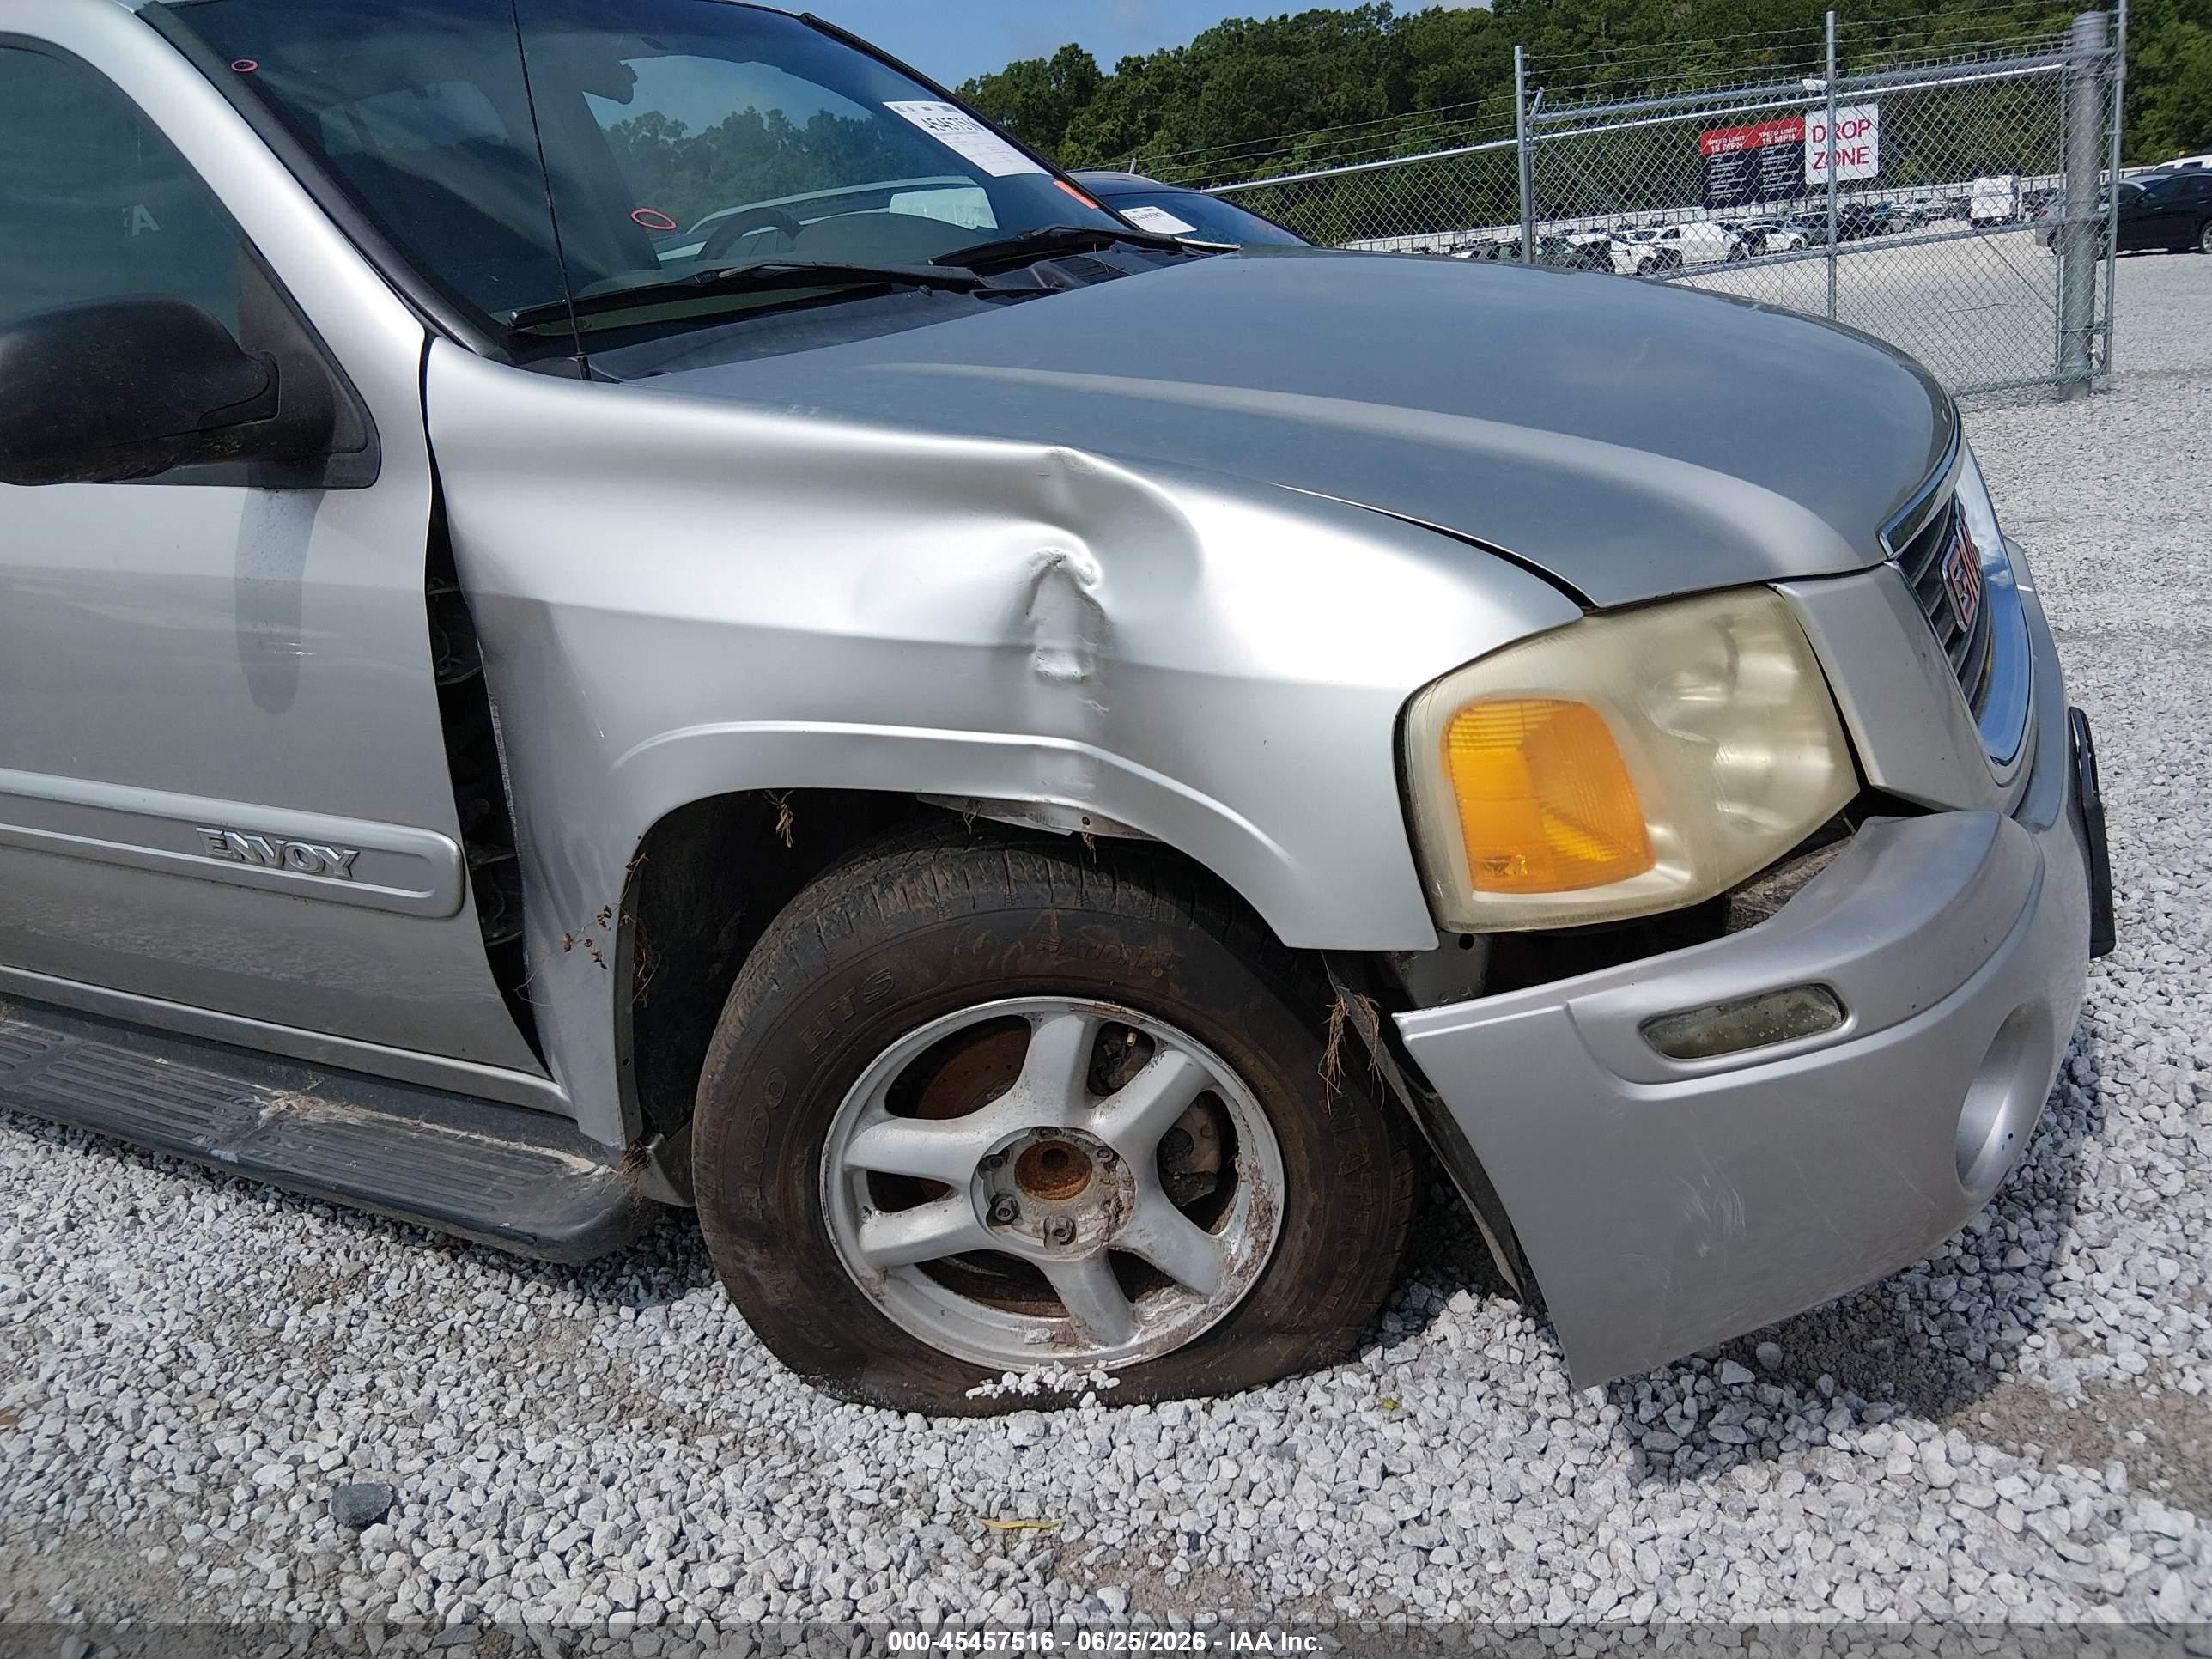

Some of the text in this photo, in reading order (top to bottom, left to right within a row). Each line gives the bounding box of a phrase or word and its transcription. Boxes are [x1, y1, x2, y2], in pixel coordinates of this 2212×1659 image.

[1723, 141, 1743, 151] MPH
[1775, 133, 1795, 143] MPH
[1813, 146, 1869, 169] ZONE
[196, 827, 360, 878] ENVOY
[799, 968, 894, 1058] HTS
